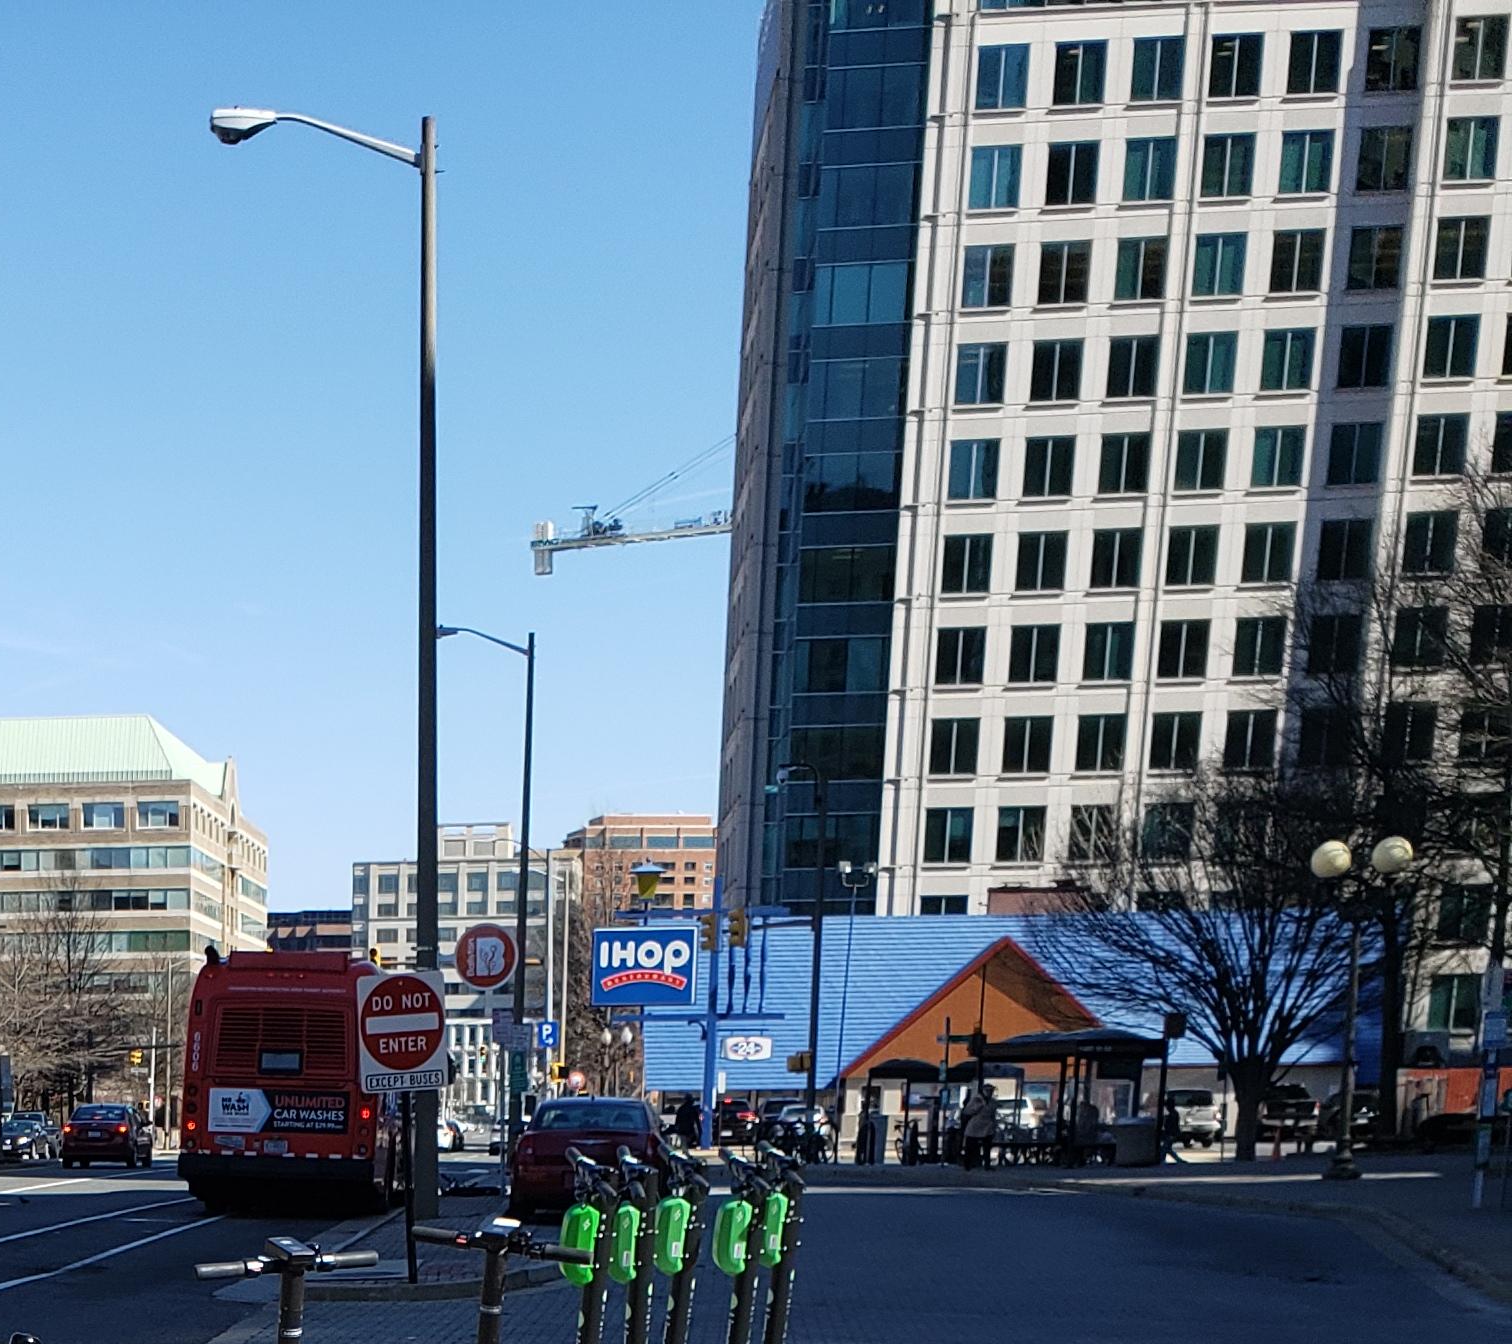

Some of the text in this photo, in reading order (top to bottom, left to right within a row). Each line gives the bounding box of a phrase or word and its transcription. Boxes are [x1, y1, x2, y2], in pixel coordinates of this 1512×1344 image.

[599, 940, 690, 975] IHOP
[372, 992, 431, 1011] DO NOT
[379, 1036, 427, 1054] ENTER
[369, 1072, 440, 1088] EXCEPT BUSES
[275, 1095, 345, 1109] UNLIMITED
[273, 1109, 344, 1121] CAR WASHES
[273, 1120, 305, 1128] STARTING
